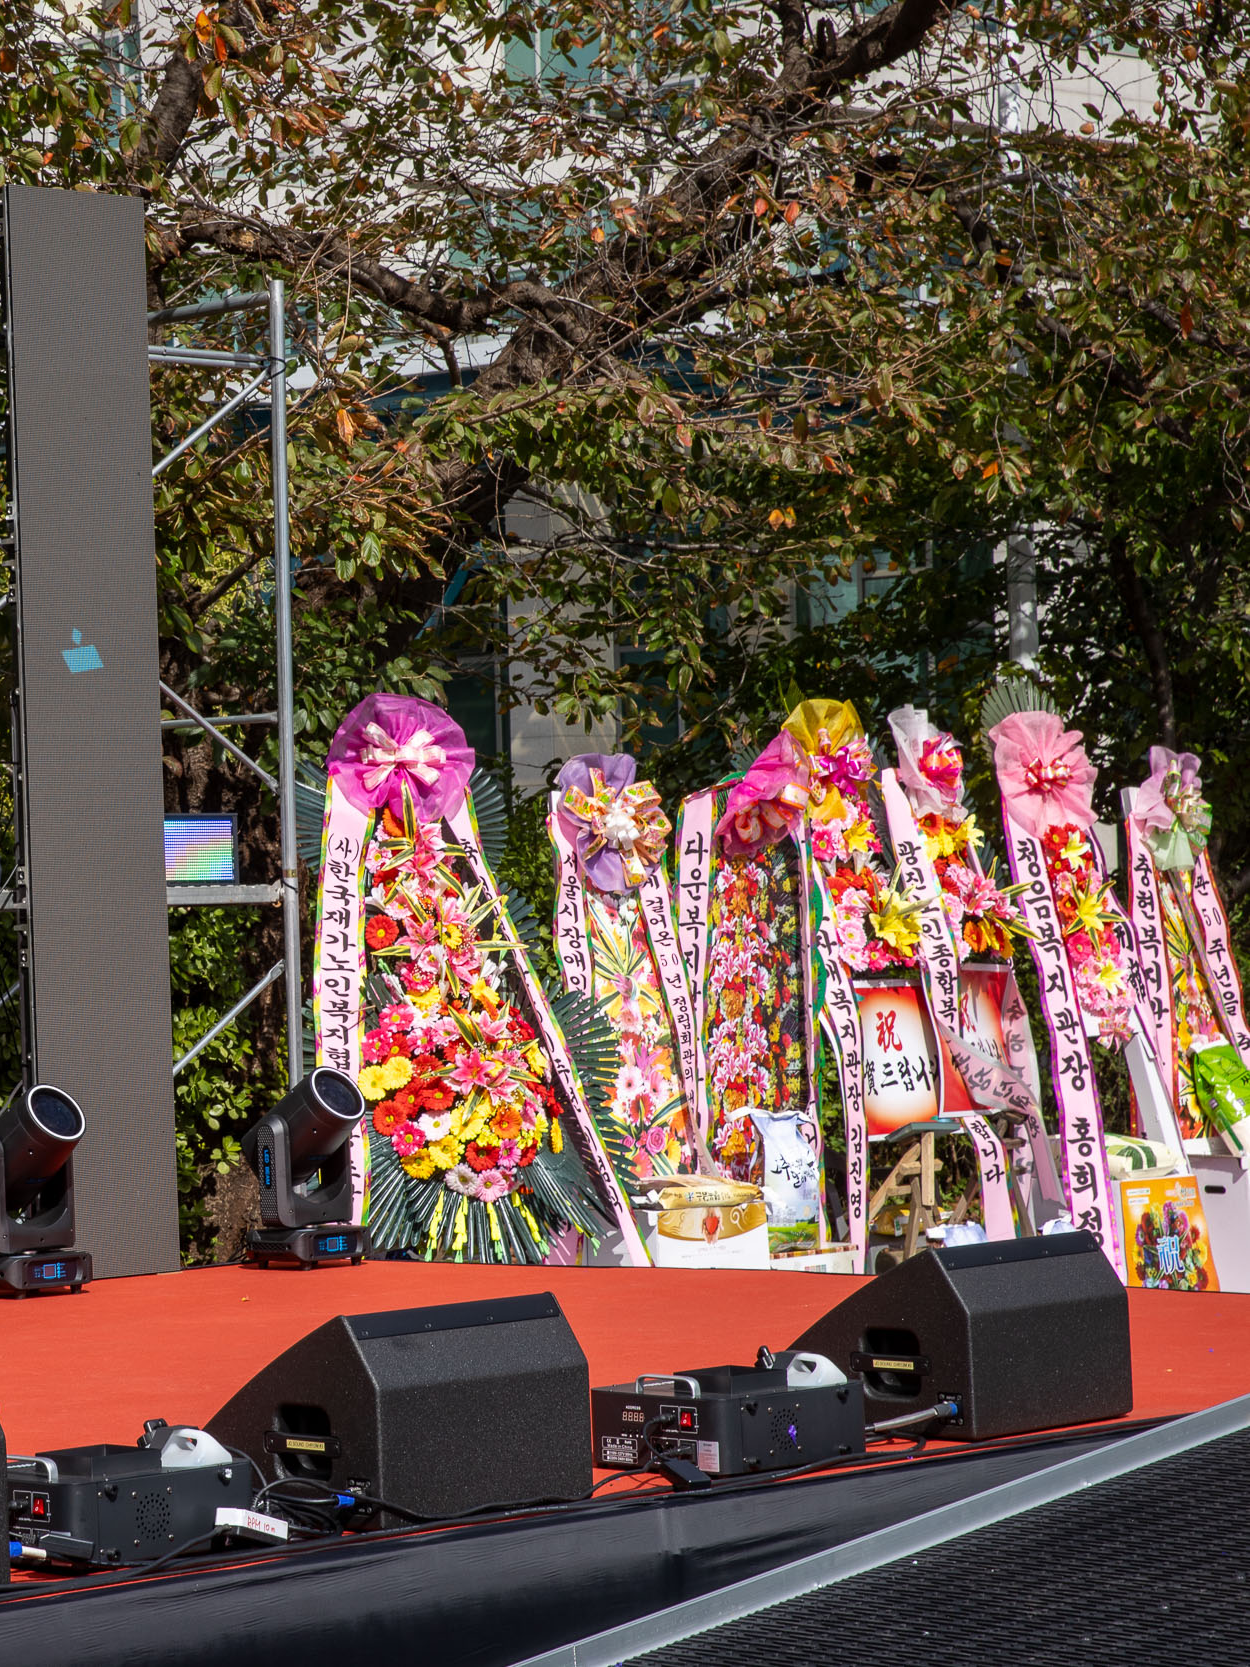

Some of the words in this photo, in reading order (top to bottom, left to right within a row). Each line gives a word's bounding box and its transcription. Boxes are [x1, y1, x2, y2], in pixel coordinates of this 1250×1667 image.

[322, 832, 360, 1072] (사)한국재가노인복지협
[558, 852, 586, 992] 서울시장애인
[646, 896, 674, 947] 걸어온
[875, 1009, 903, 1054] 祝
[970, 1119, 1005, 1185] 합니다
[1067, 1117, 1104, 1246] 홍희정
[1156, 1234, 1185, 1275] 祝
